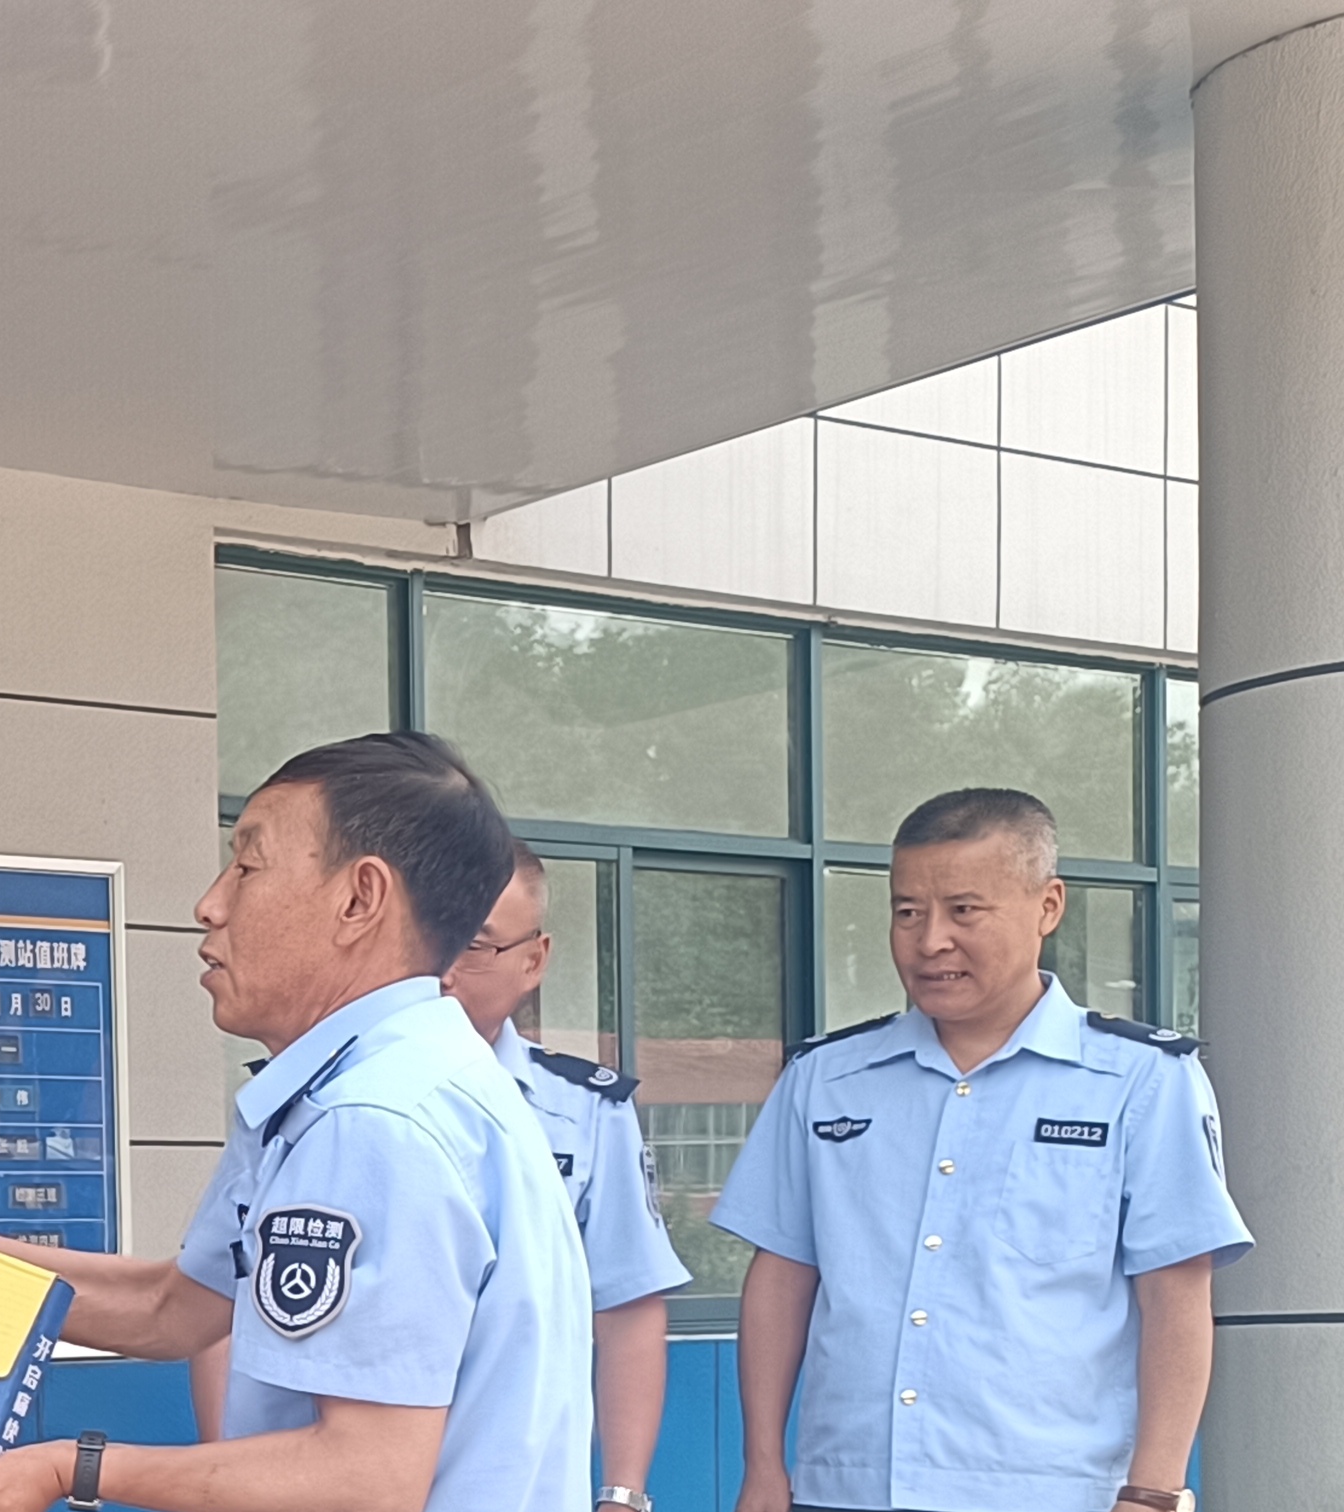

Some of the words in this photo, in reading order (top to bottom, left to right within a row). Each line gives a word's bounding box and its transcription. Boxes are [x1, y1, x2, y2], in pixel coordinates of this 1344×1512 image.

[1040, 1122, 1103, 1142] 010212
[271, 1216, 345, 1239] 超限检测
